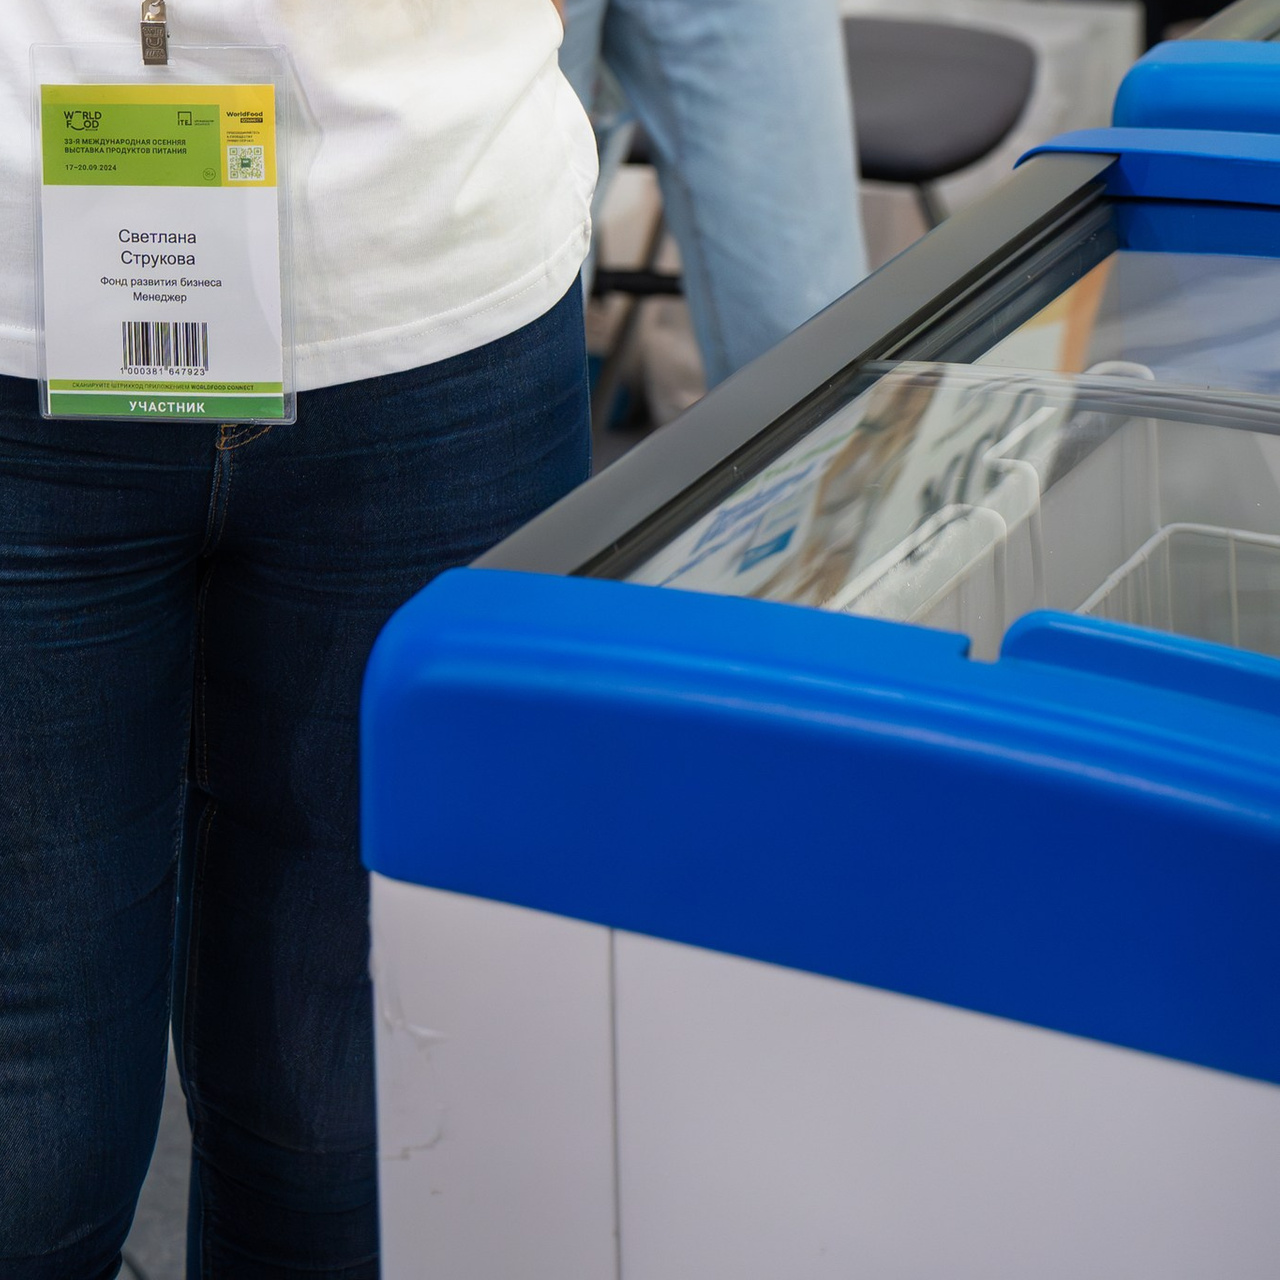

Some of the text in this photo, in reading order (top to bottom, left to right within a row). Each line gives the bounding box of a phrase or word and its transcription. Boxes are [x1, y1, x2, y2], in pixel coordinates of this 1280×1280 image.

[64, 138, 80, 146] 33-Я
[81, 138, 151, 146] МЕЖДУНАРОДНАЯ
[105, 147, 151, 155] ПРОДУКТОВ
[118, 228, 197, 244] Светлана
[120, 250, 196, 269] Струкова
[100, 276, 223, 288] Фонд развития бизнеса
[132, 291, 188, 304] Менеджер
[129, 399, 207, 414] УЧАСТНИК
